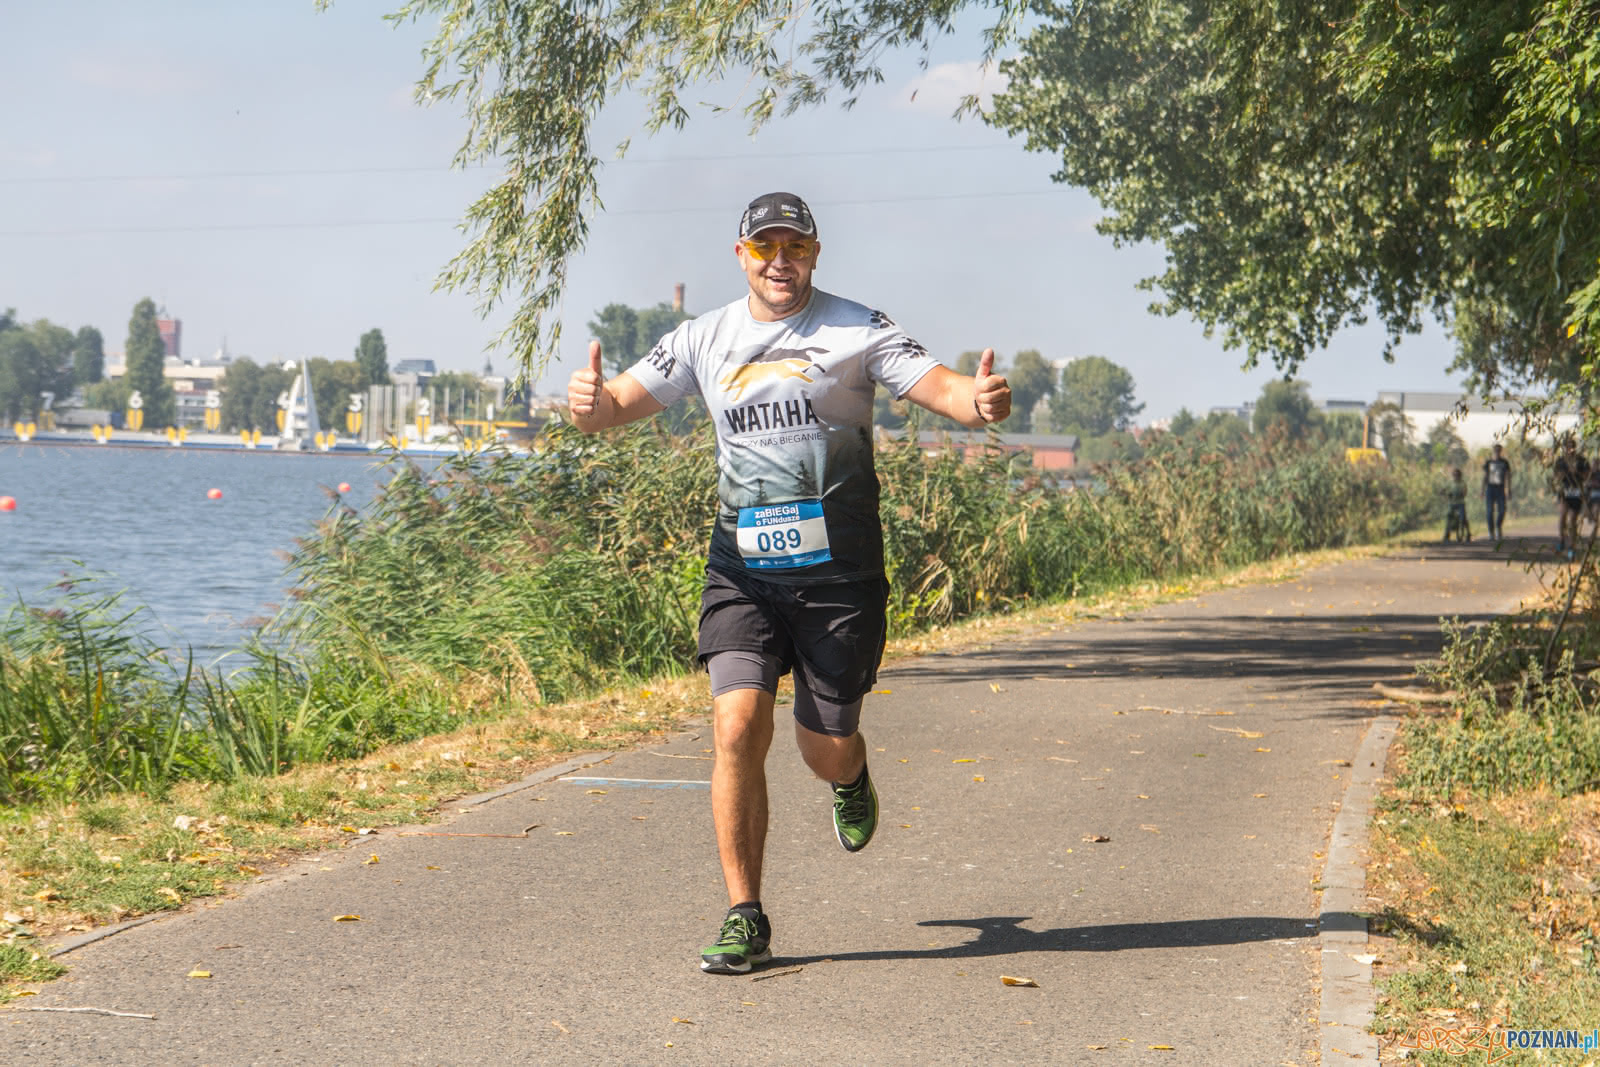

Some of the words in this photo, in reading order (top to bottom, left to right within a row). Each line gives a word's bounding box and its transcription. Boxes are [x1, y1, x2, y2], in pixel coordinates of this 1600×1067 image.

[41, 391, 56, 410] 7
[128, 390, 144, 409] 6
[206, 390, 221, 409] 5
[349, 393, 362, 411] 3
[418, 398, 430, 416] 2
[724, 398, 820, 434] WATAHA
[760, 438, 778, 447] NAS
[754, 504, 799, 519] zaBIEGaj
[762, 515, 800, 525] FUNdusze
[757, 528, 801, 552] 089
